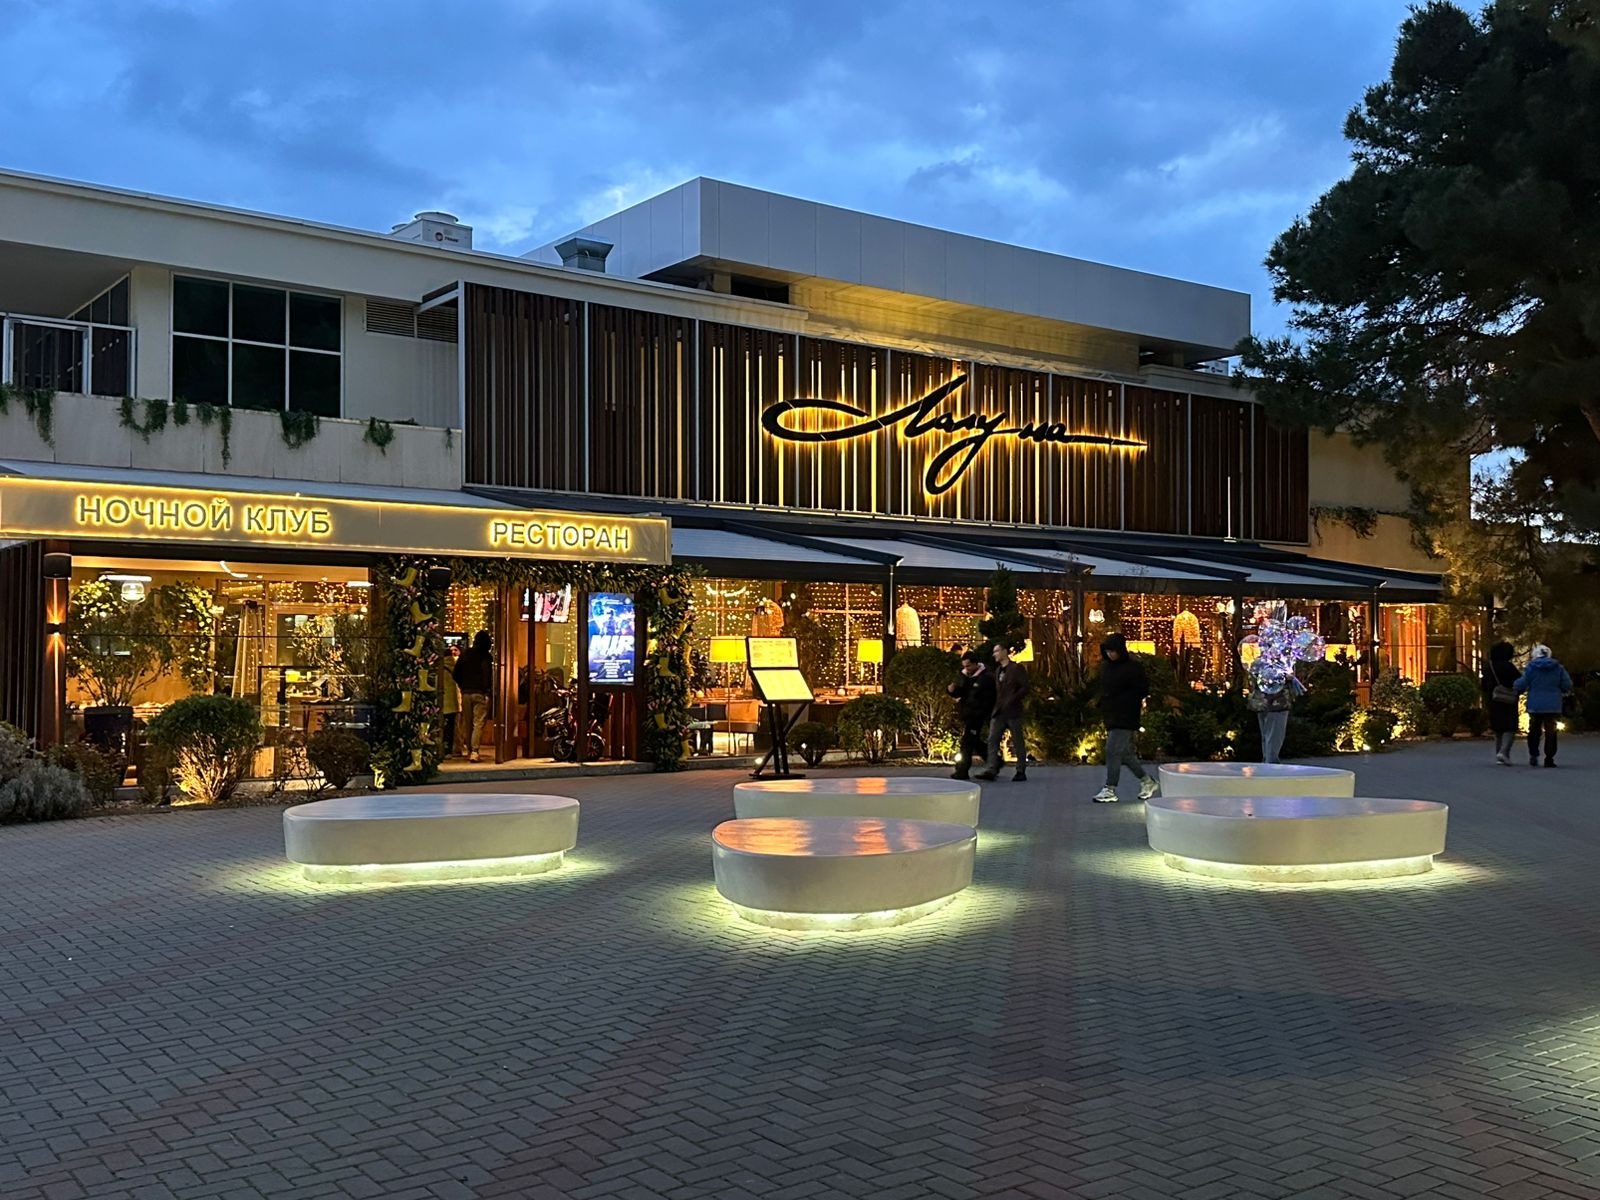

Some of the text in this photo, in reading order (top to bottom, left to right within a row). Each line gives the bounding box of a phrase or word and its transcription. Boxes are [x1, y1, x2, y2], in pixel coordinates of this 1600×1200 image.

[79, 497, 330, 534] НОЧНОЙ КЛУБ
[493, 522, 629, 549] РЕСТОРАН
